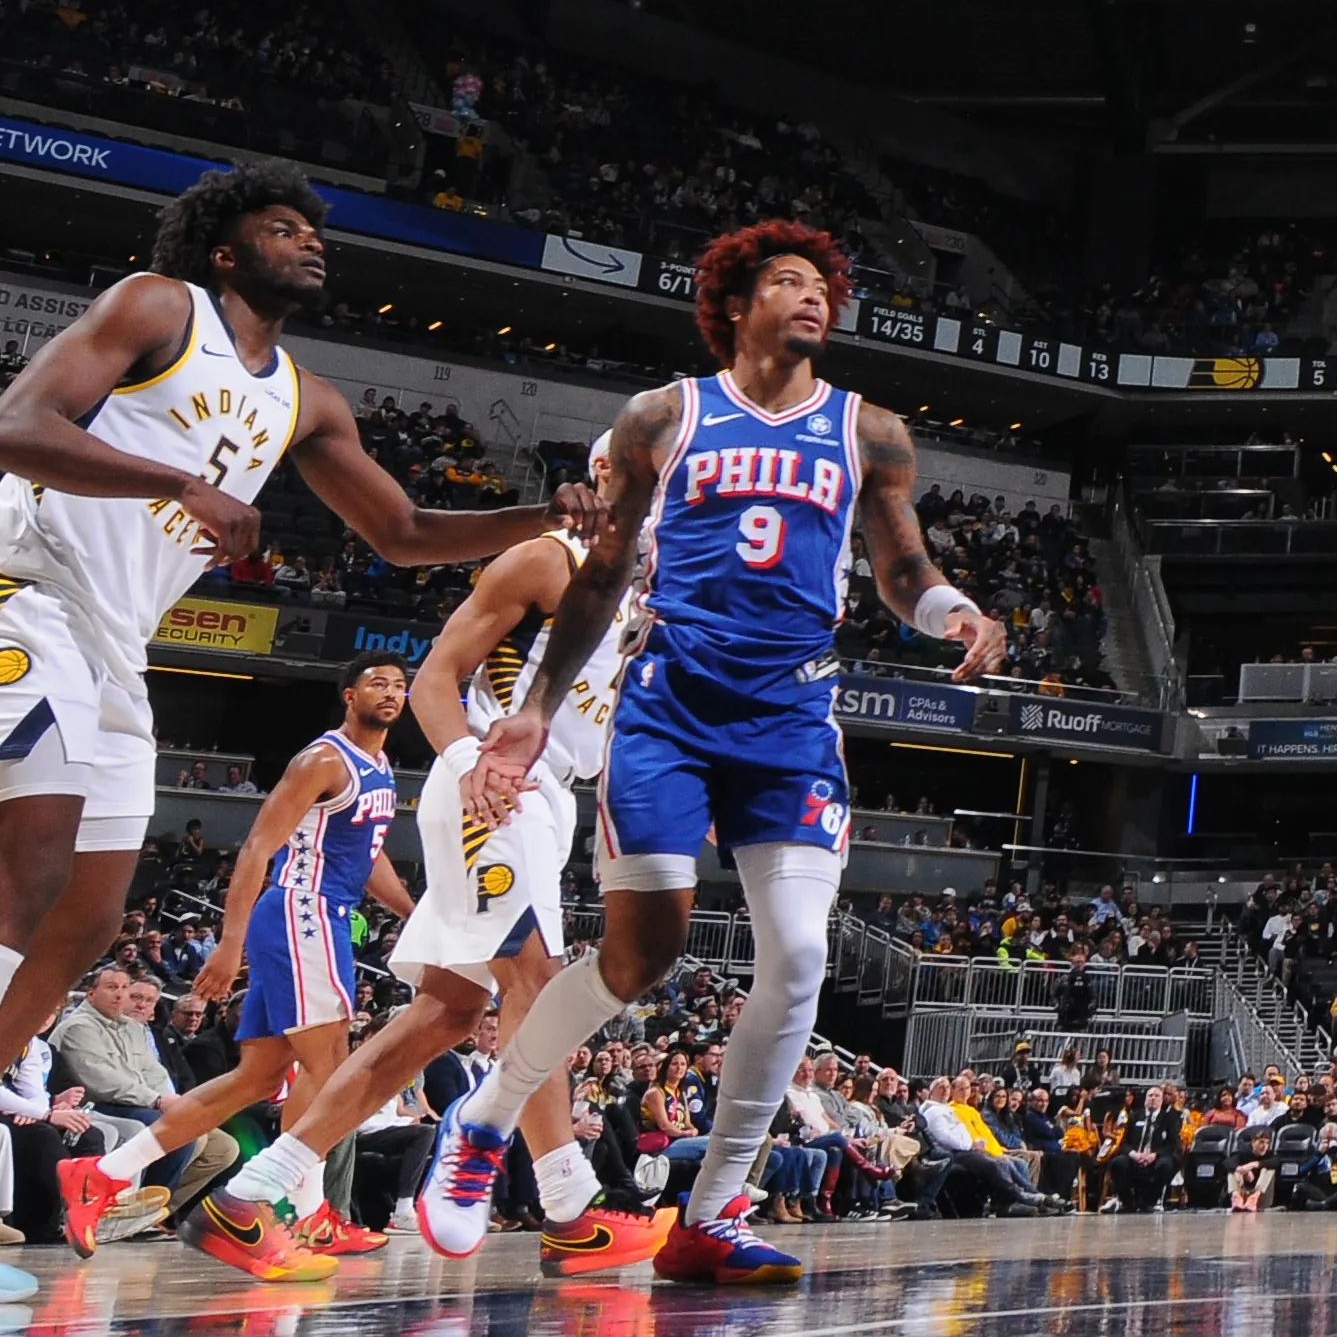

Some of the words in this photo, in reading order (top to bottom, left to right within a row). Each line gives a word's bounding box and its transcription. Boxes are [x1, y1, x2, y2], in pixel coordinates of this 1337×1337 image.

[658, 274, 697, 296] 6/1
[873, 306, 896, 318] FIELD
[897, 311, 924, 324] GOALS
[871, 316, 925, 343] 14/35
[972, 338, 984, 356] 4
[1033, 340, 1049, 350] AST
[1029, 349, 1051, 369] 10
[434, 366, 451, 381] 119
[1089, 361, 1109, 380] 13
[1313, 369, 1325, 386] 5
[520, 381, 537, 397] 120
[169, 388, 269, 472] INDIANA
[200, 434, 240, 488] 5
[684, 446, 844, 515] PHILA
[736, 504, 787, 569] 9
[170, 607, 248, 634] sen
[156, 626, 244, 646] ECURITY
[909, 696, 937, 710] CPAs
[938, 703, 948, 711] &
[907, 709, 956, 725] Advisors
[1047, 709, 1103, 733] Ruoff
[1101, 720, 1152, 736] MORTGAGE
[1257, 744, 1267, 754] IT
[1269, 744, 1320, 754] HAPPENS.
[801, 793, 844, 835] 76
[370, 824, 390, 862] 5
